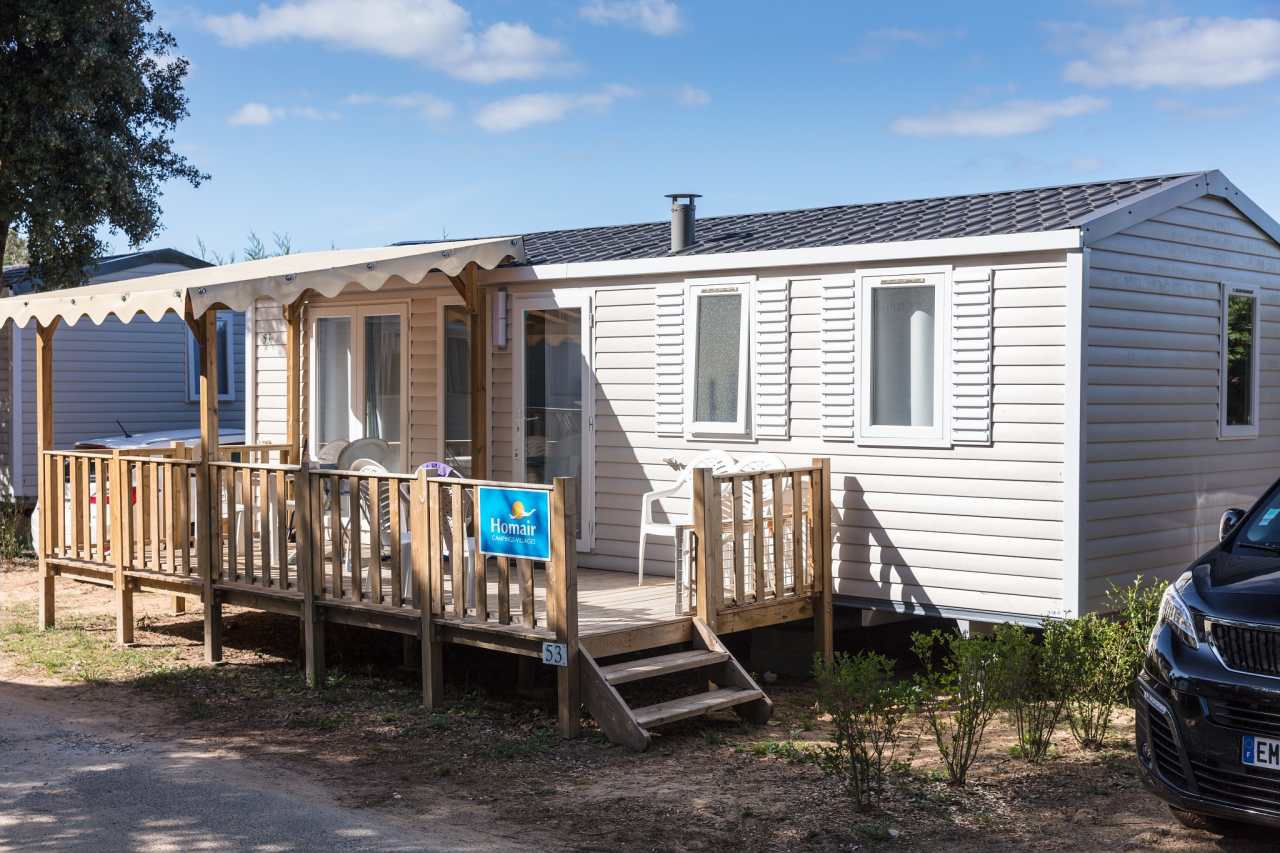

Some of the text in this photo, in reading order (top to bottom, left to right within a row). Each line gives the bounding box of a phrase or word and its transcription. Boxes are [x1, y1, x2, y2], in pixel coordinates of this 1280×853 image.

[490, 517, 536, 536] Homair
[545, 644, 562, 663] 53
[1257, 741, 1279, 765] EM
